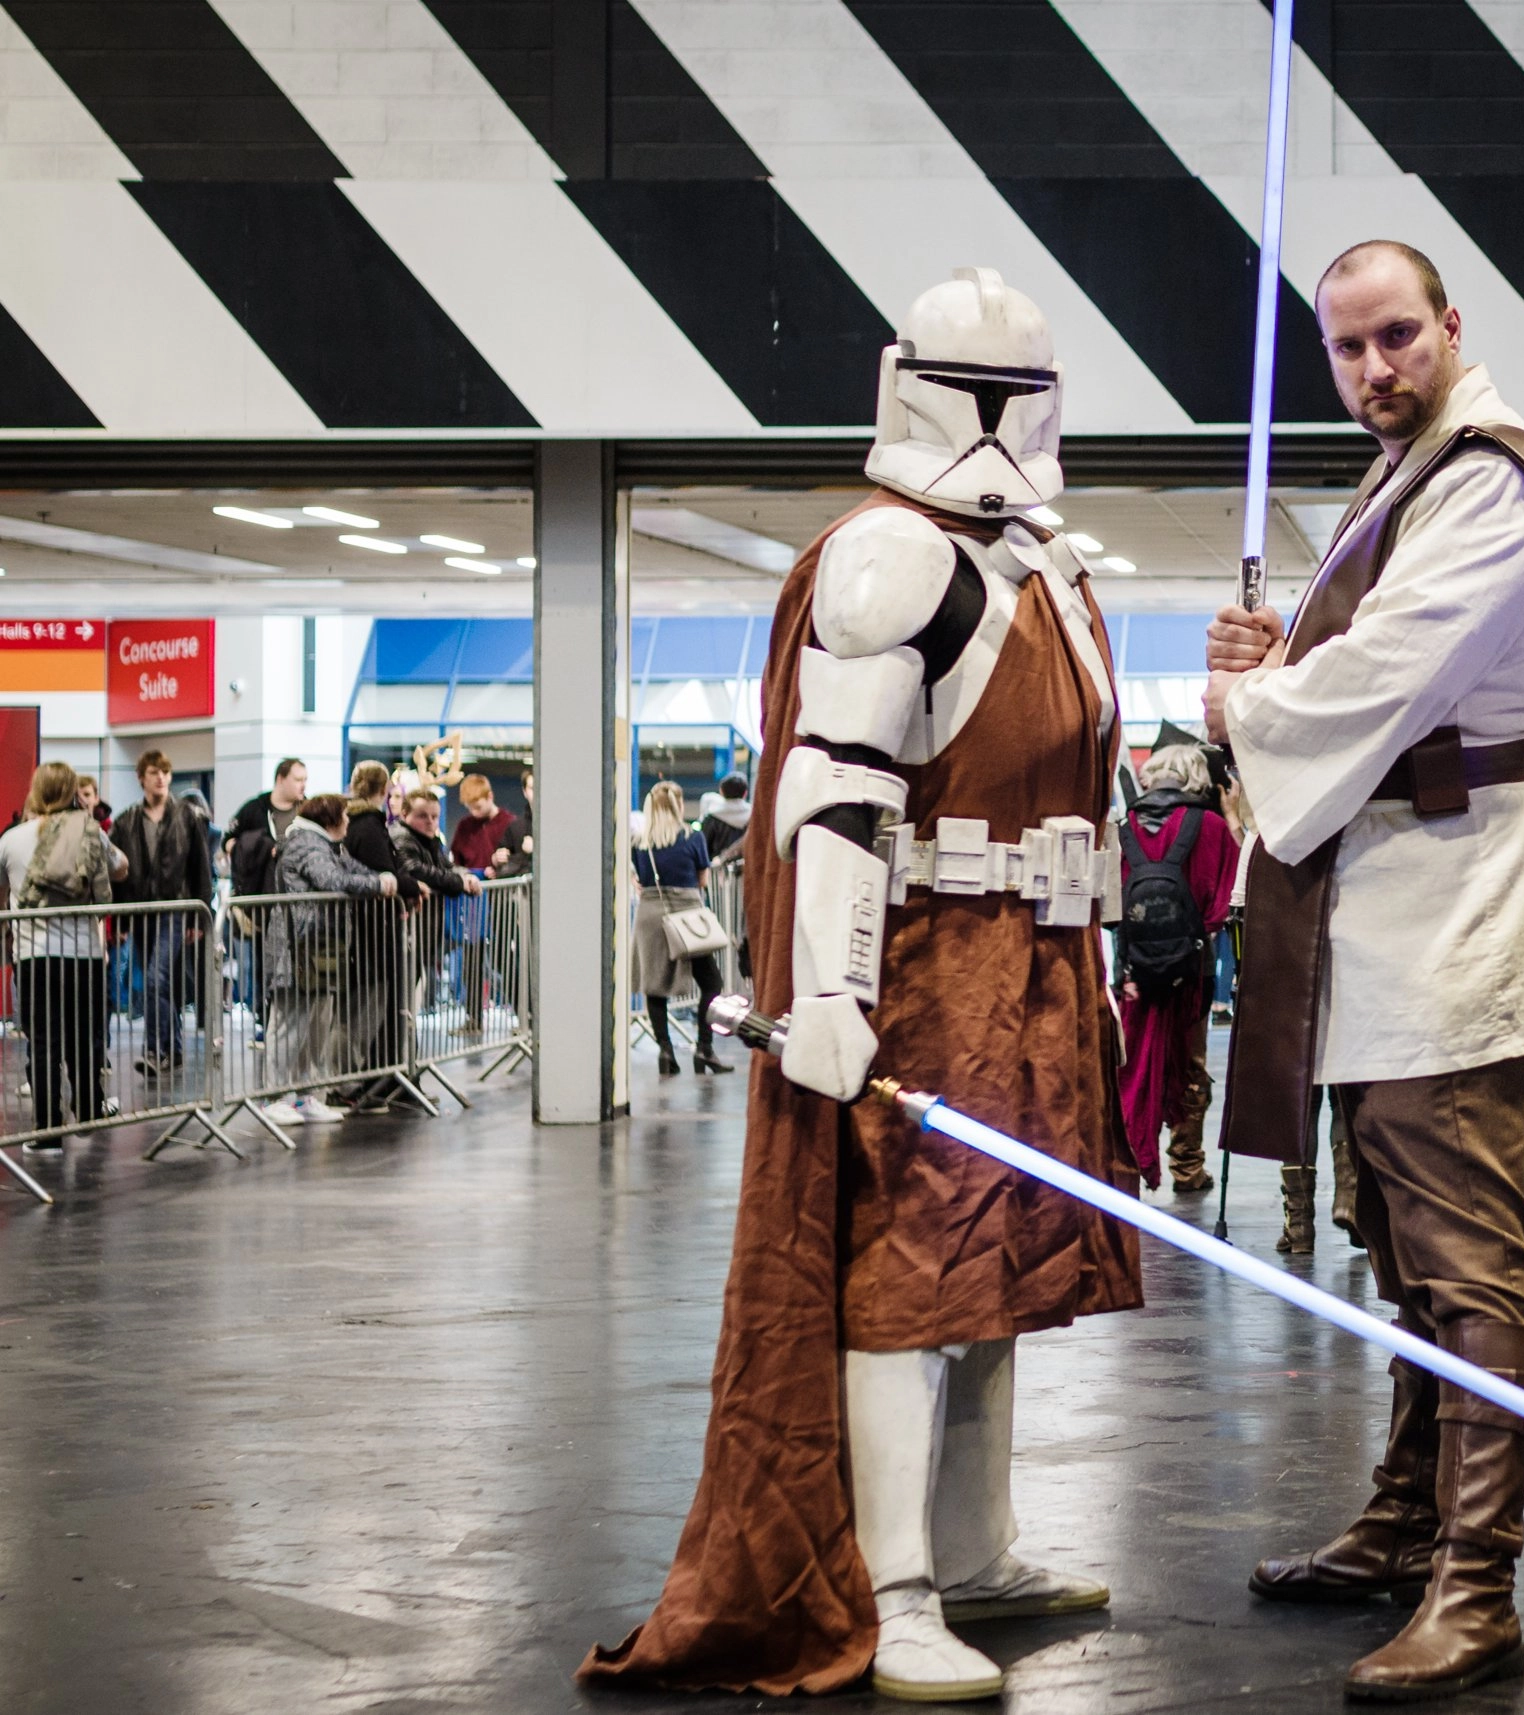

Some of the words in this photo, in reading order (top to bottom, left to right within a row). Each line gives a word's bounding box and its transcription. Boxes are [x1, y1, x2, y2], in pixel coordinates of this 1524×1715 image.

[33, 622, 66, 640] 9-12
[119, 636, 199, 666] Concourse
[139, 671, 178, 701] Suite
